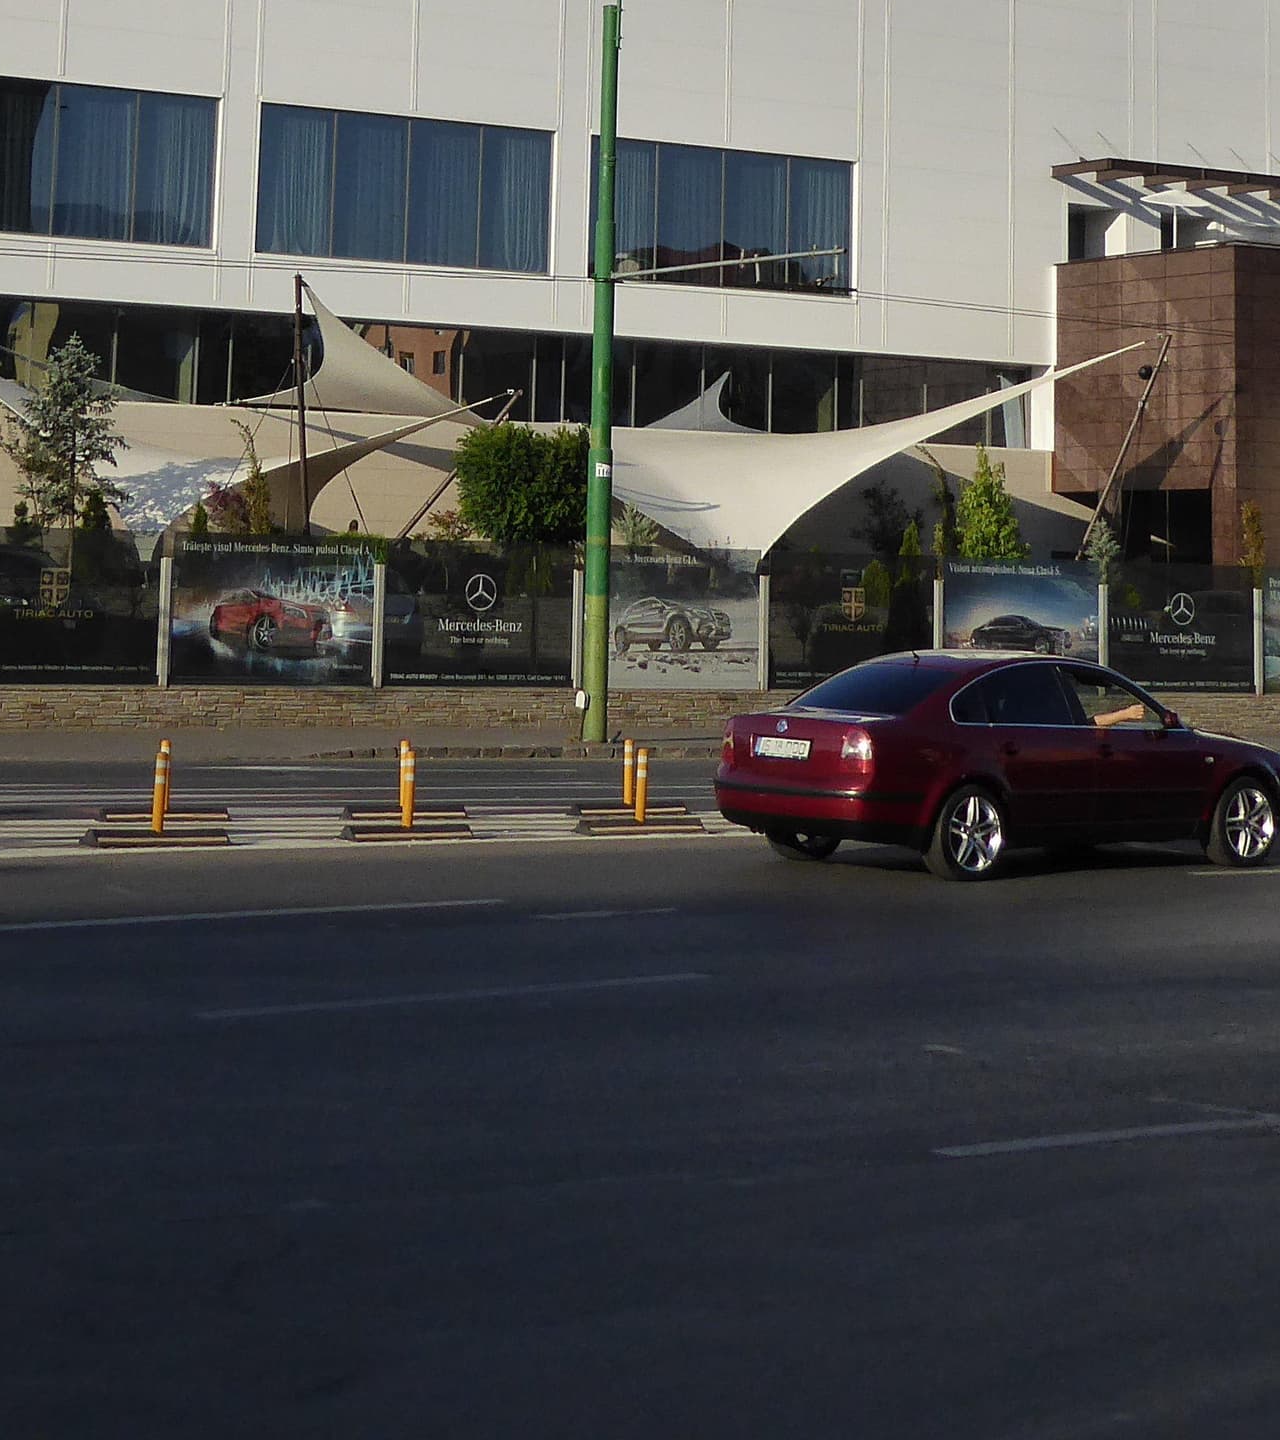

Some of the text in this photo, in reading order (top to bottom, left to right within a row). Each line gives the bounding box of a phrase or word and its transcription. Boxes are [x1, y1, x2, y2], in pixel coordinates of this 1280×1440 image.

[58, 609, 94, 618] AUTO
[438, 618, 523, 633] Mercedes-Benz
[856, 624, 884, 633] AUTO
[1150, 631, 1216, 645] Mercedes-Benz
